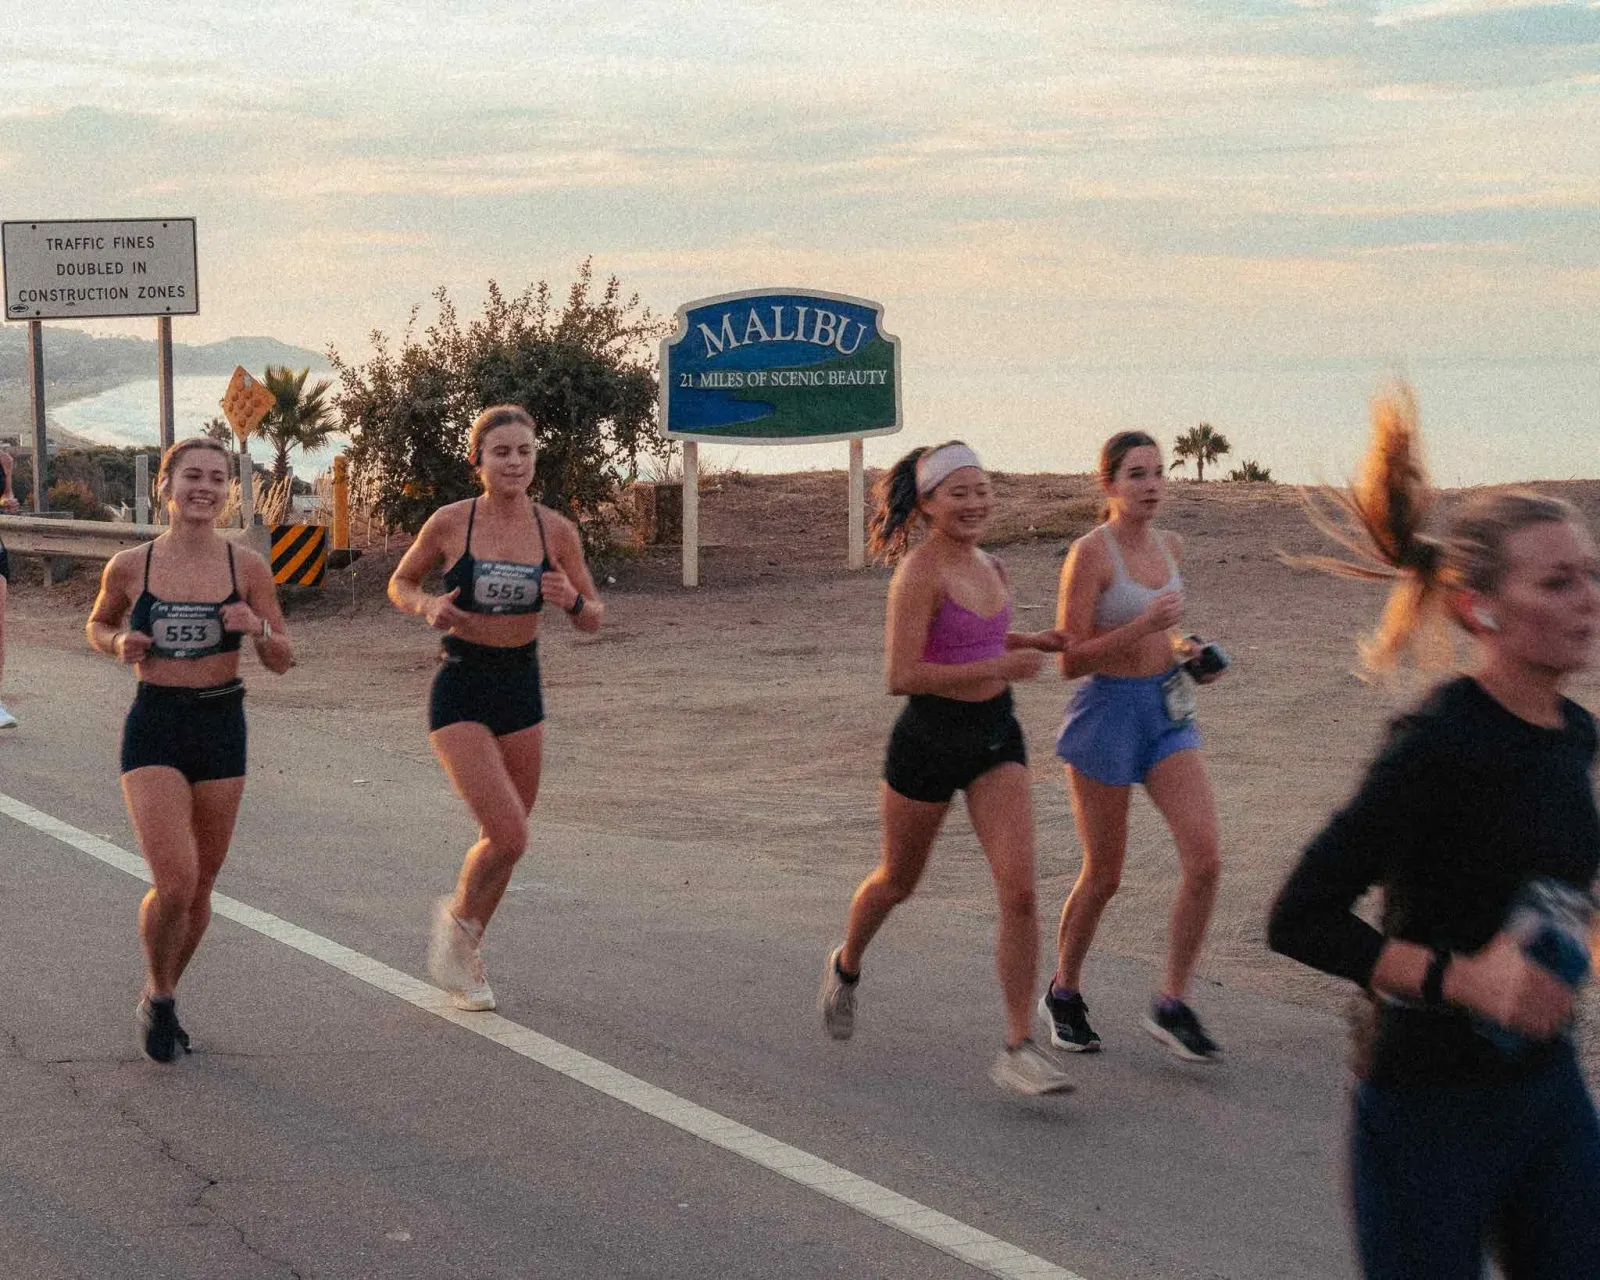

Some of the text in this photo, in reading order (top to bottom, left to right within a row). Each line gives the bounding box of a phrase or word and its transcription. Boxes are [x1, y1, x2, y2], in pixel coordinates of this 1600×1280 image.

[46, 236, 155, 251] TRAFFIC FINES
[56, 261, 147, 276] DOUBLED IN
[19, 285, 186, 302] CONSTRUCTION ZONES
[697, 305, 867, 358] MALIBU
[679, 369, 888, 388] 21 MILES OF SCENIC BEAUTY
[486, 582, 526, 600] 555
[165, 625, 207, 642] 553
